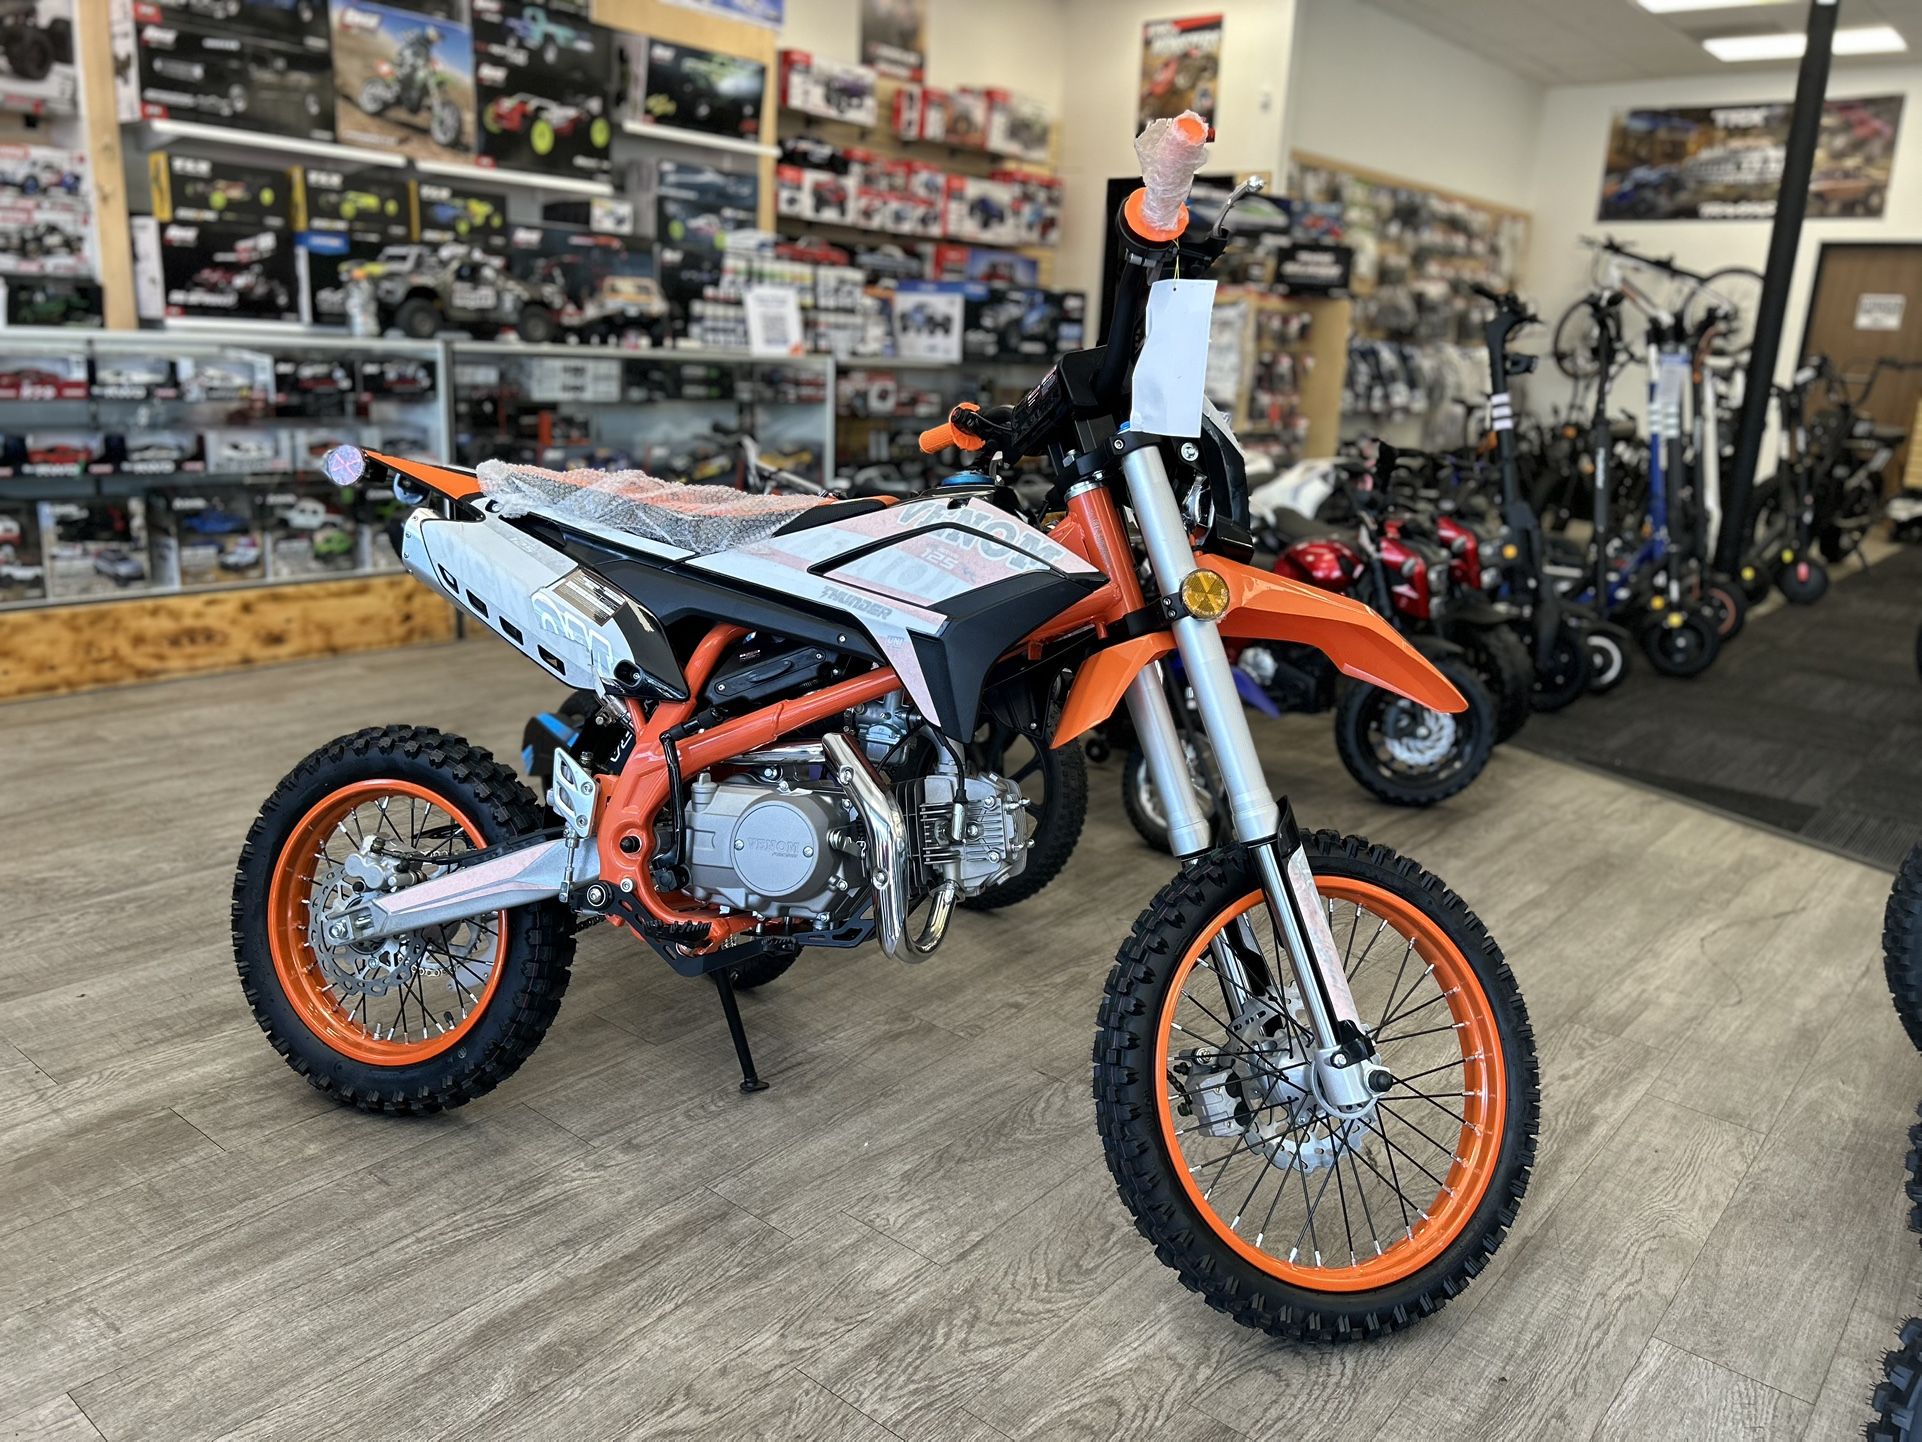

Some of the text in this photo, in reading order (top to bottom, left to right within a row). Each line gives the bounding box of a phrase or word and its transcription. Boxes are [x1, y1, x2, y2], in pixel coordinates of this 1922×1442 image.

[897, 501, 1067, 572] VENOM
[921, 548, 959, 570] 125
[818, 585, 893, 620] THUNDER
[747, 837, 800, 854] VENOM
